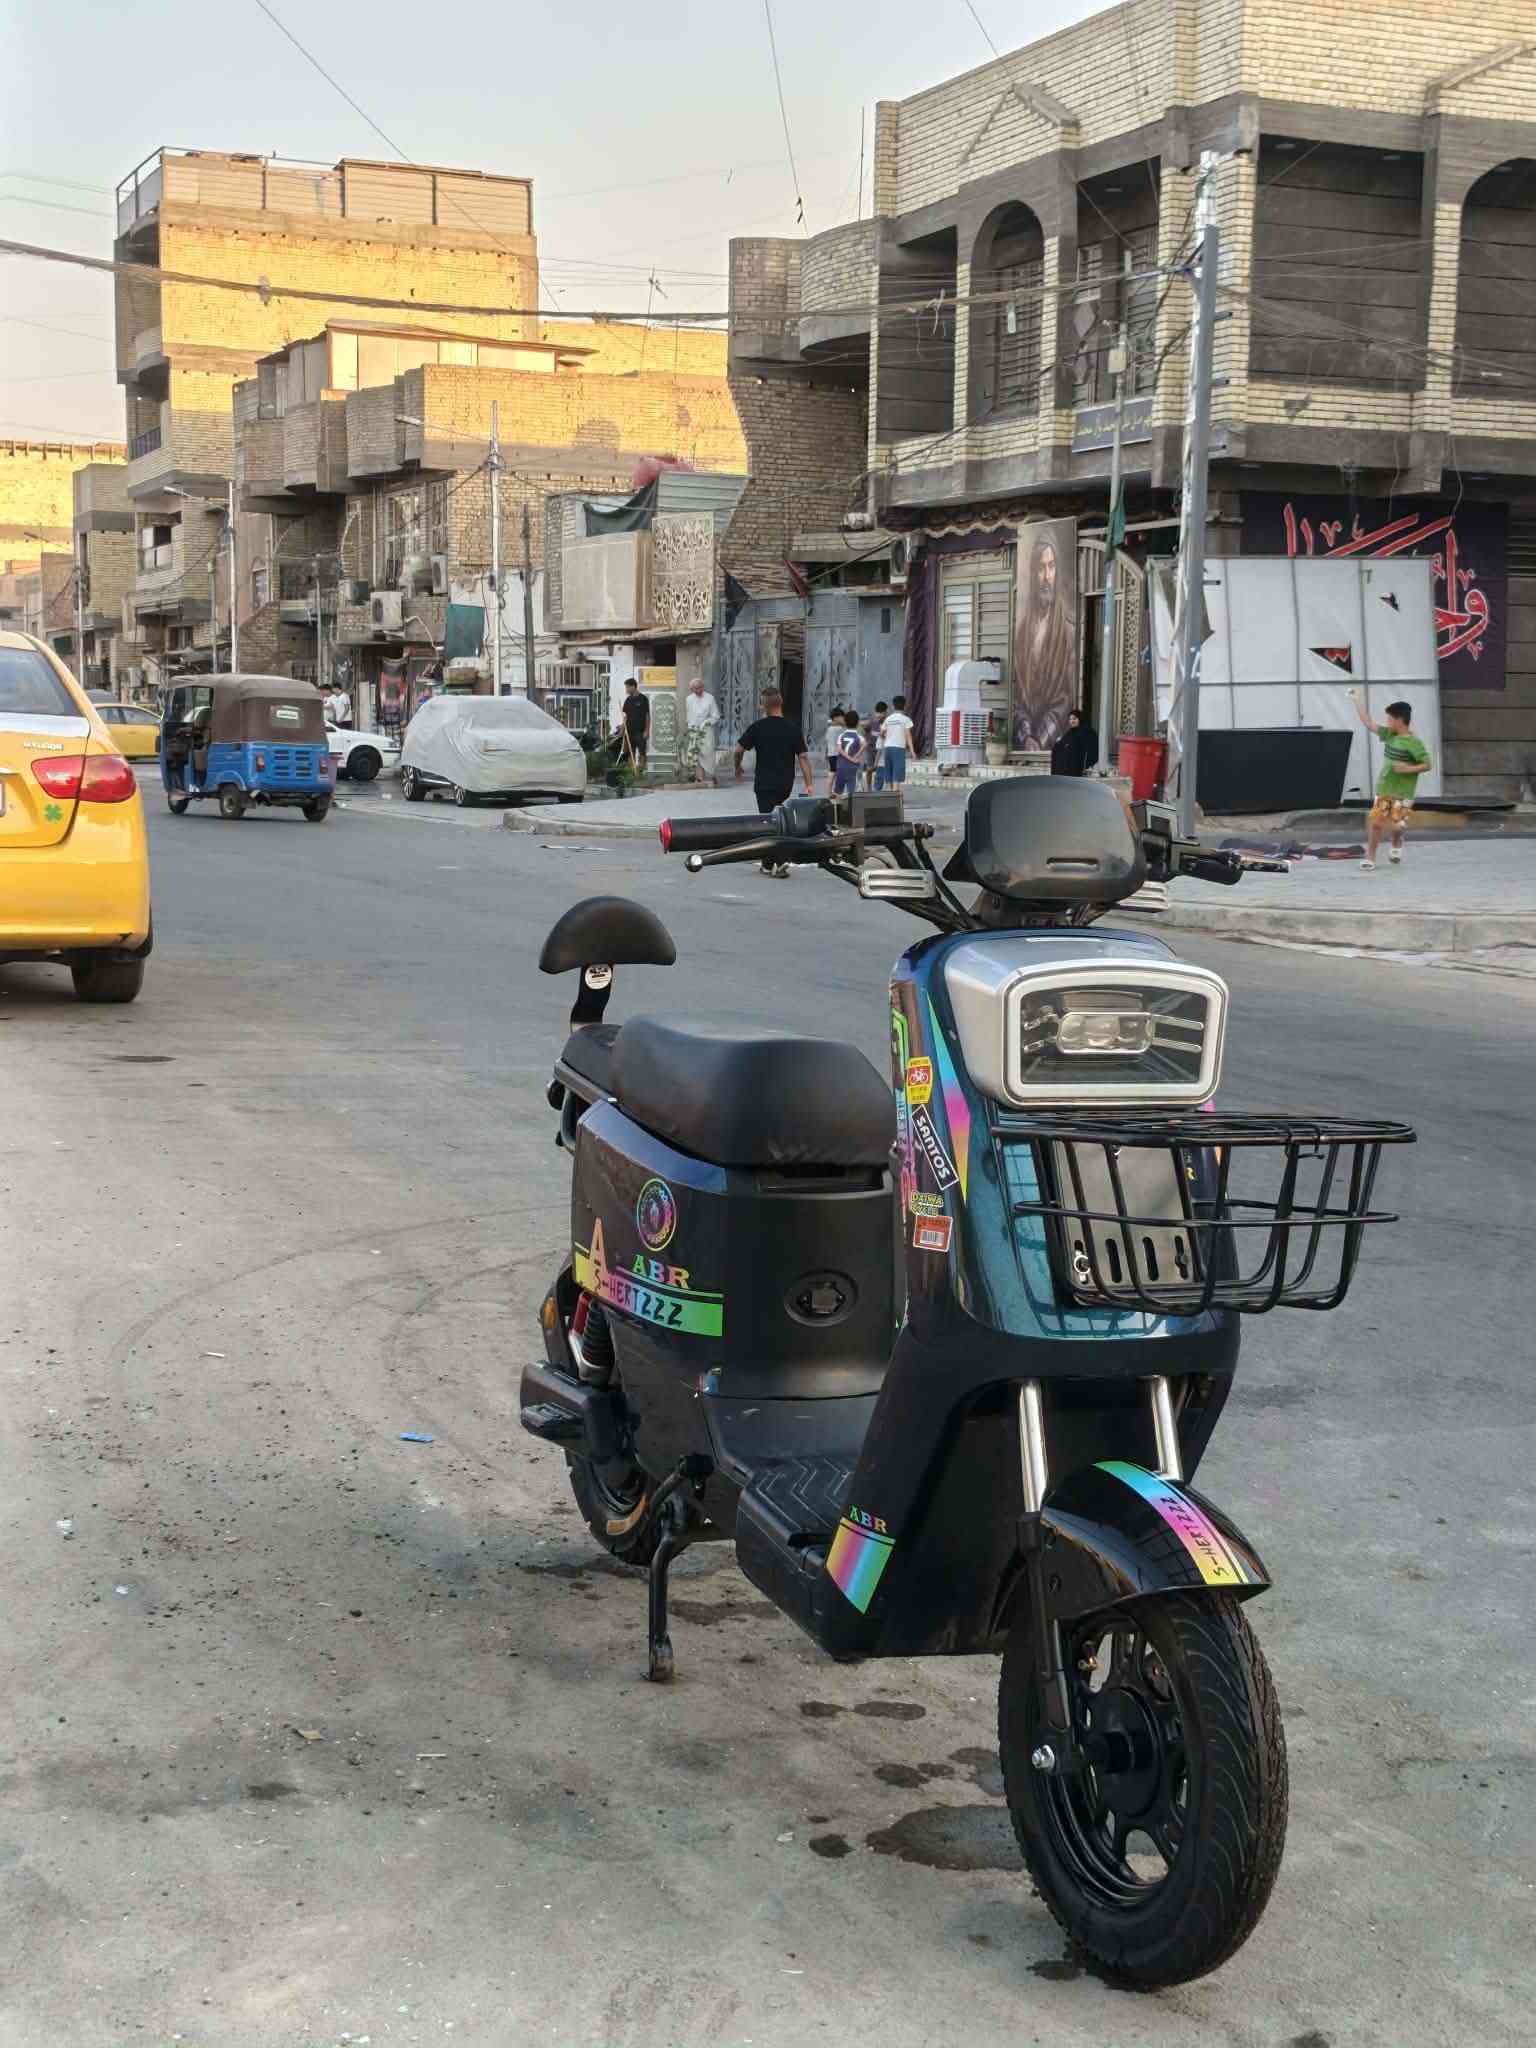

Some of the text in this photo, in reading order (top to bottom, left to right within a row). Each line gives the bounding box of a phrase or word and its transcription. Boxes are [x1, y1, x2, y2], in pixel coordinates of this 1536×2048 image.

[843, 737, 855, 753] 7
[916, 1115, 951, 1179] SANTOS
[632, 1254, 690, 1290] ABR
[850, 1504, 888, 1534] ABR
